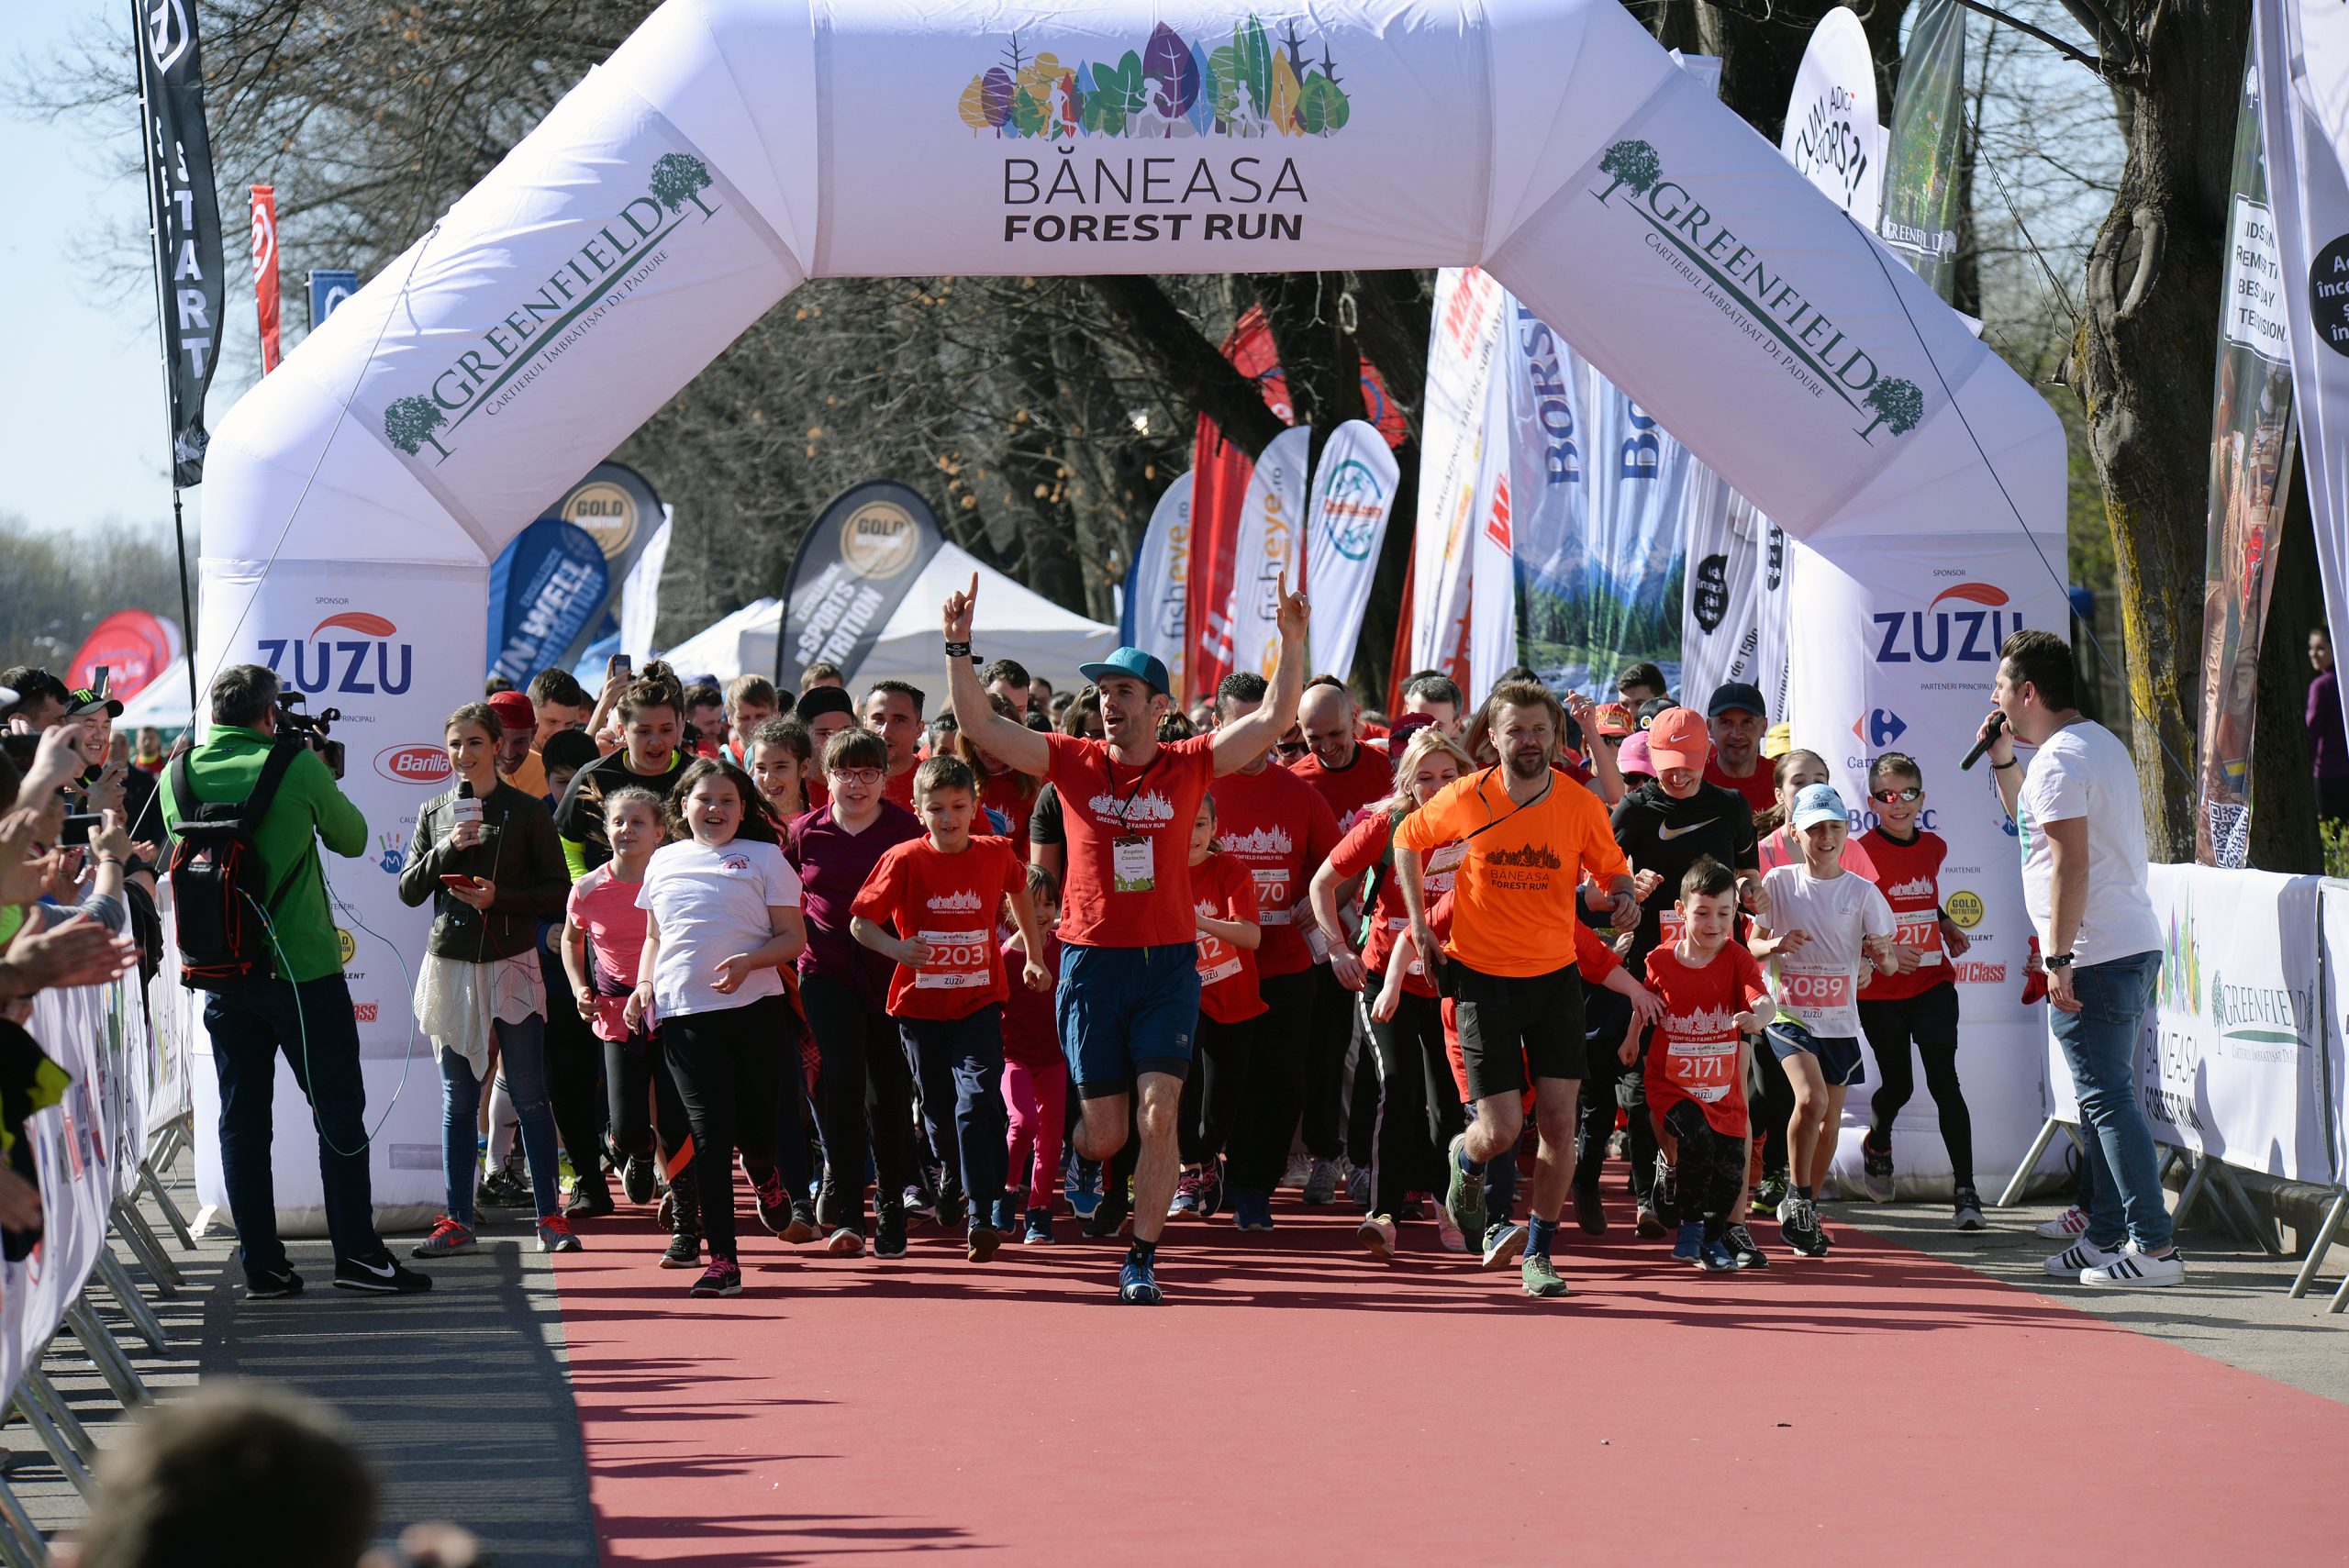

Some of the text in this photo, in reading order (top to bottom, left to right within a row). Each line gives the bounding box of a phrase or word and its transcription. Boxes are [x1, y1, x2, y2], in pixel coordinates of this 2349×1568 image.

[1004, 145, 1308, 205] BĂNEASA
[1004, 213, 1303, 242] FOREST RUN
[173, 139, 211, 379] START
[1648, 182, 1879, 391] GREENFIELD
[431, 196, 663, 411] GREENFIELD
[1644, 232, 1703, 290] CARTIERUL
[1763, 339, 1782, 360] DE
[1779, 351, 1826, 398] PĂDURE
[484, 361, 548, 417] CARTIERUL
[606, 290, 628, 309] DE
[623, 249, 670, 293] PĂDURE
[575, 500, 624, 517] GOLD
[1932, 569, 1966, 577] SPONSOR
[315, 596, 350, 606] SPONSOR
[797, 579, 856, 654] SPORTS
[258, 639, 412, 695] ZUZU
[1920, 683, 1993, 691] PARTENERI PRINCIPALI
[396, 753, 451, 773] Barilla
[1490, 869, 1550, 882] BĂNEASA
[1491, 879, 1549, 891] FOREST RUN
[1950, 907, 1980, 916] NUTRITION
[1952, 898, 1977, 908] GOLD
[925, 945, 985, 966] 2203
[944, 977, 965, 985] ZUZU
[1969, 962, 2008, 984] Class
[1782, 974, 1843, 998] 2089
[1802, 1010, 1823, 1018] ZUZU
[2222, 984, 2308, 1033] GREENFIELD
[1677, 1056, 1721, 1078] 2171
[2144, 1085, 2206, 1131] FOREST RUN
